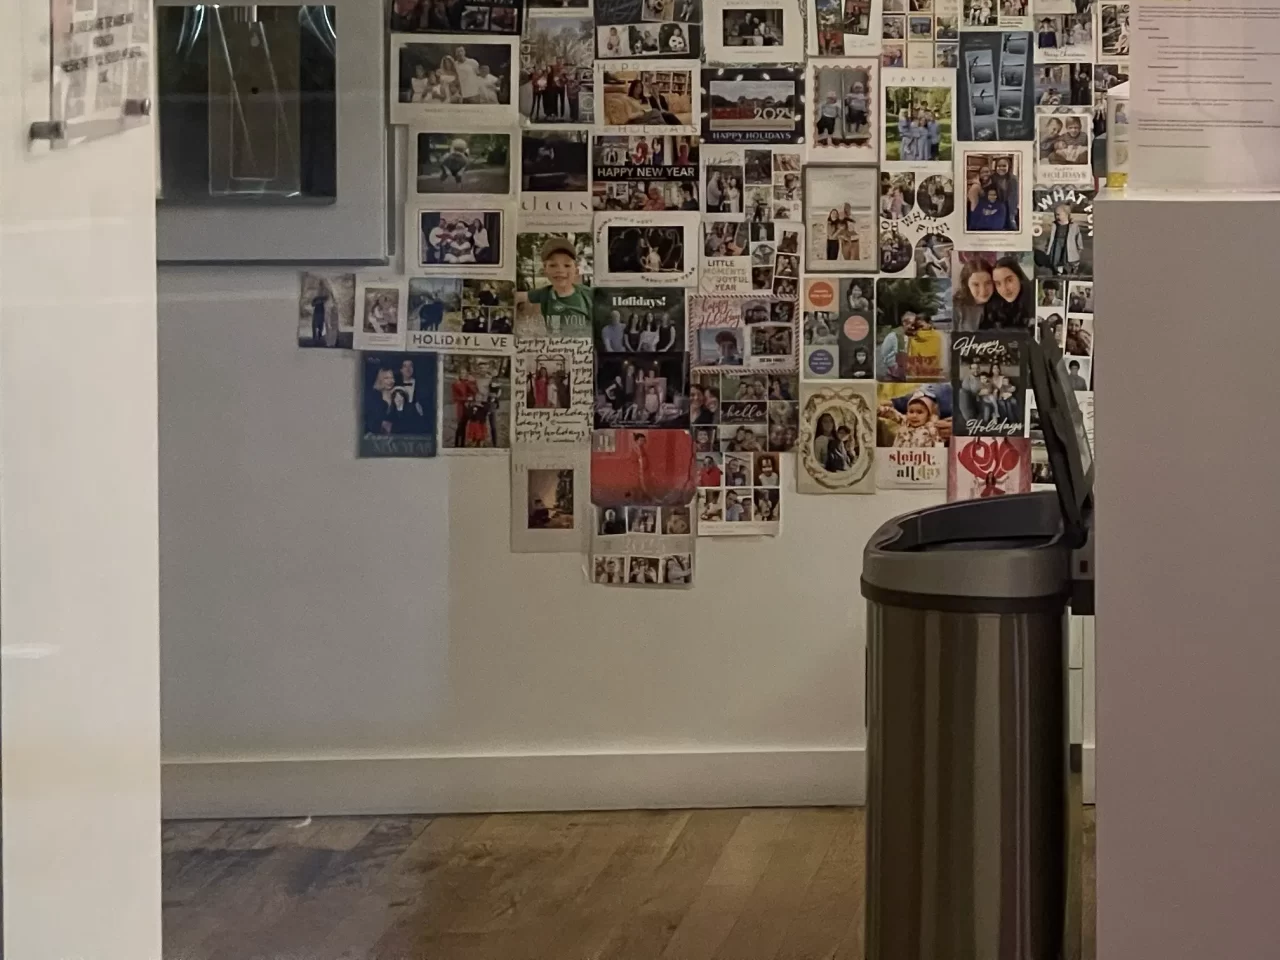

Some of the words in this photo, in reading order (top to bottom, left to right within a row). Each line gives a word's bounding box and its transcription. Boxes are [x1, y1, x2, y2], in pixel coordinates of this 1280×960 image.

[597, 168, 633, 177] HAPPY
[637, 167, 663, 176] NEW
[666, 167, 695, 176] YEAR
[1038, 190, 1086, 210] WHAT
[916, 223, 950, 234] FUN!
[612, 296, 666, 307] Holidays!
[564, 315, 586, 326] YOU
[953, 335, 1004, 355] Happy
[724, 405, 767, 418] hello
[966, 418, 1025, 435] Holidays
[888, 451, 936, 466] sleigh
[895, 465, 920, 482] all
